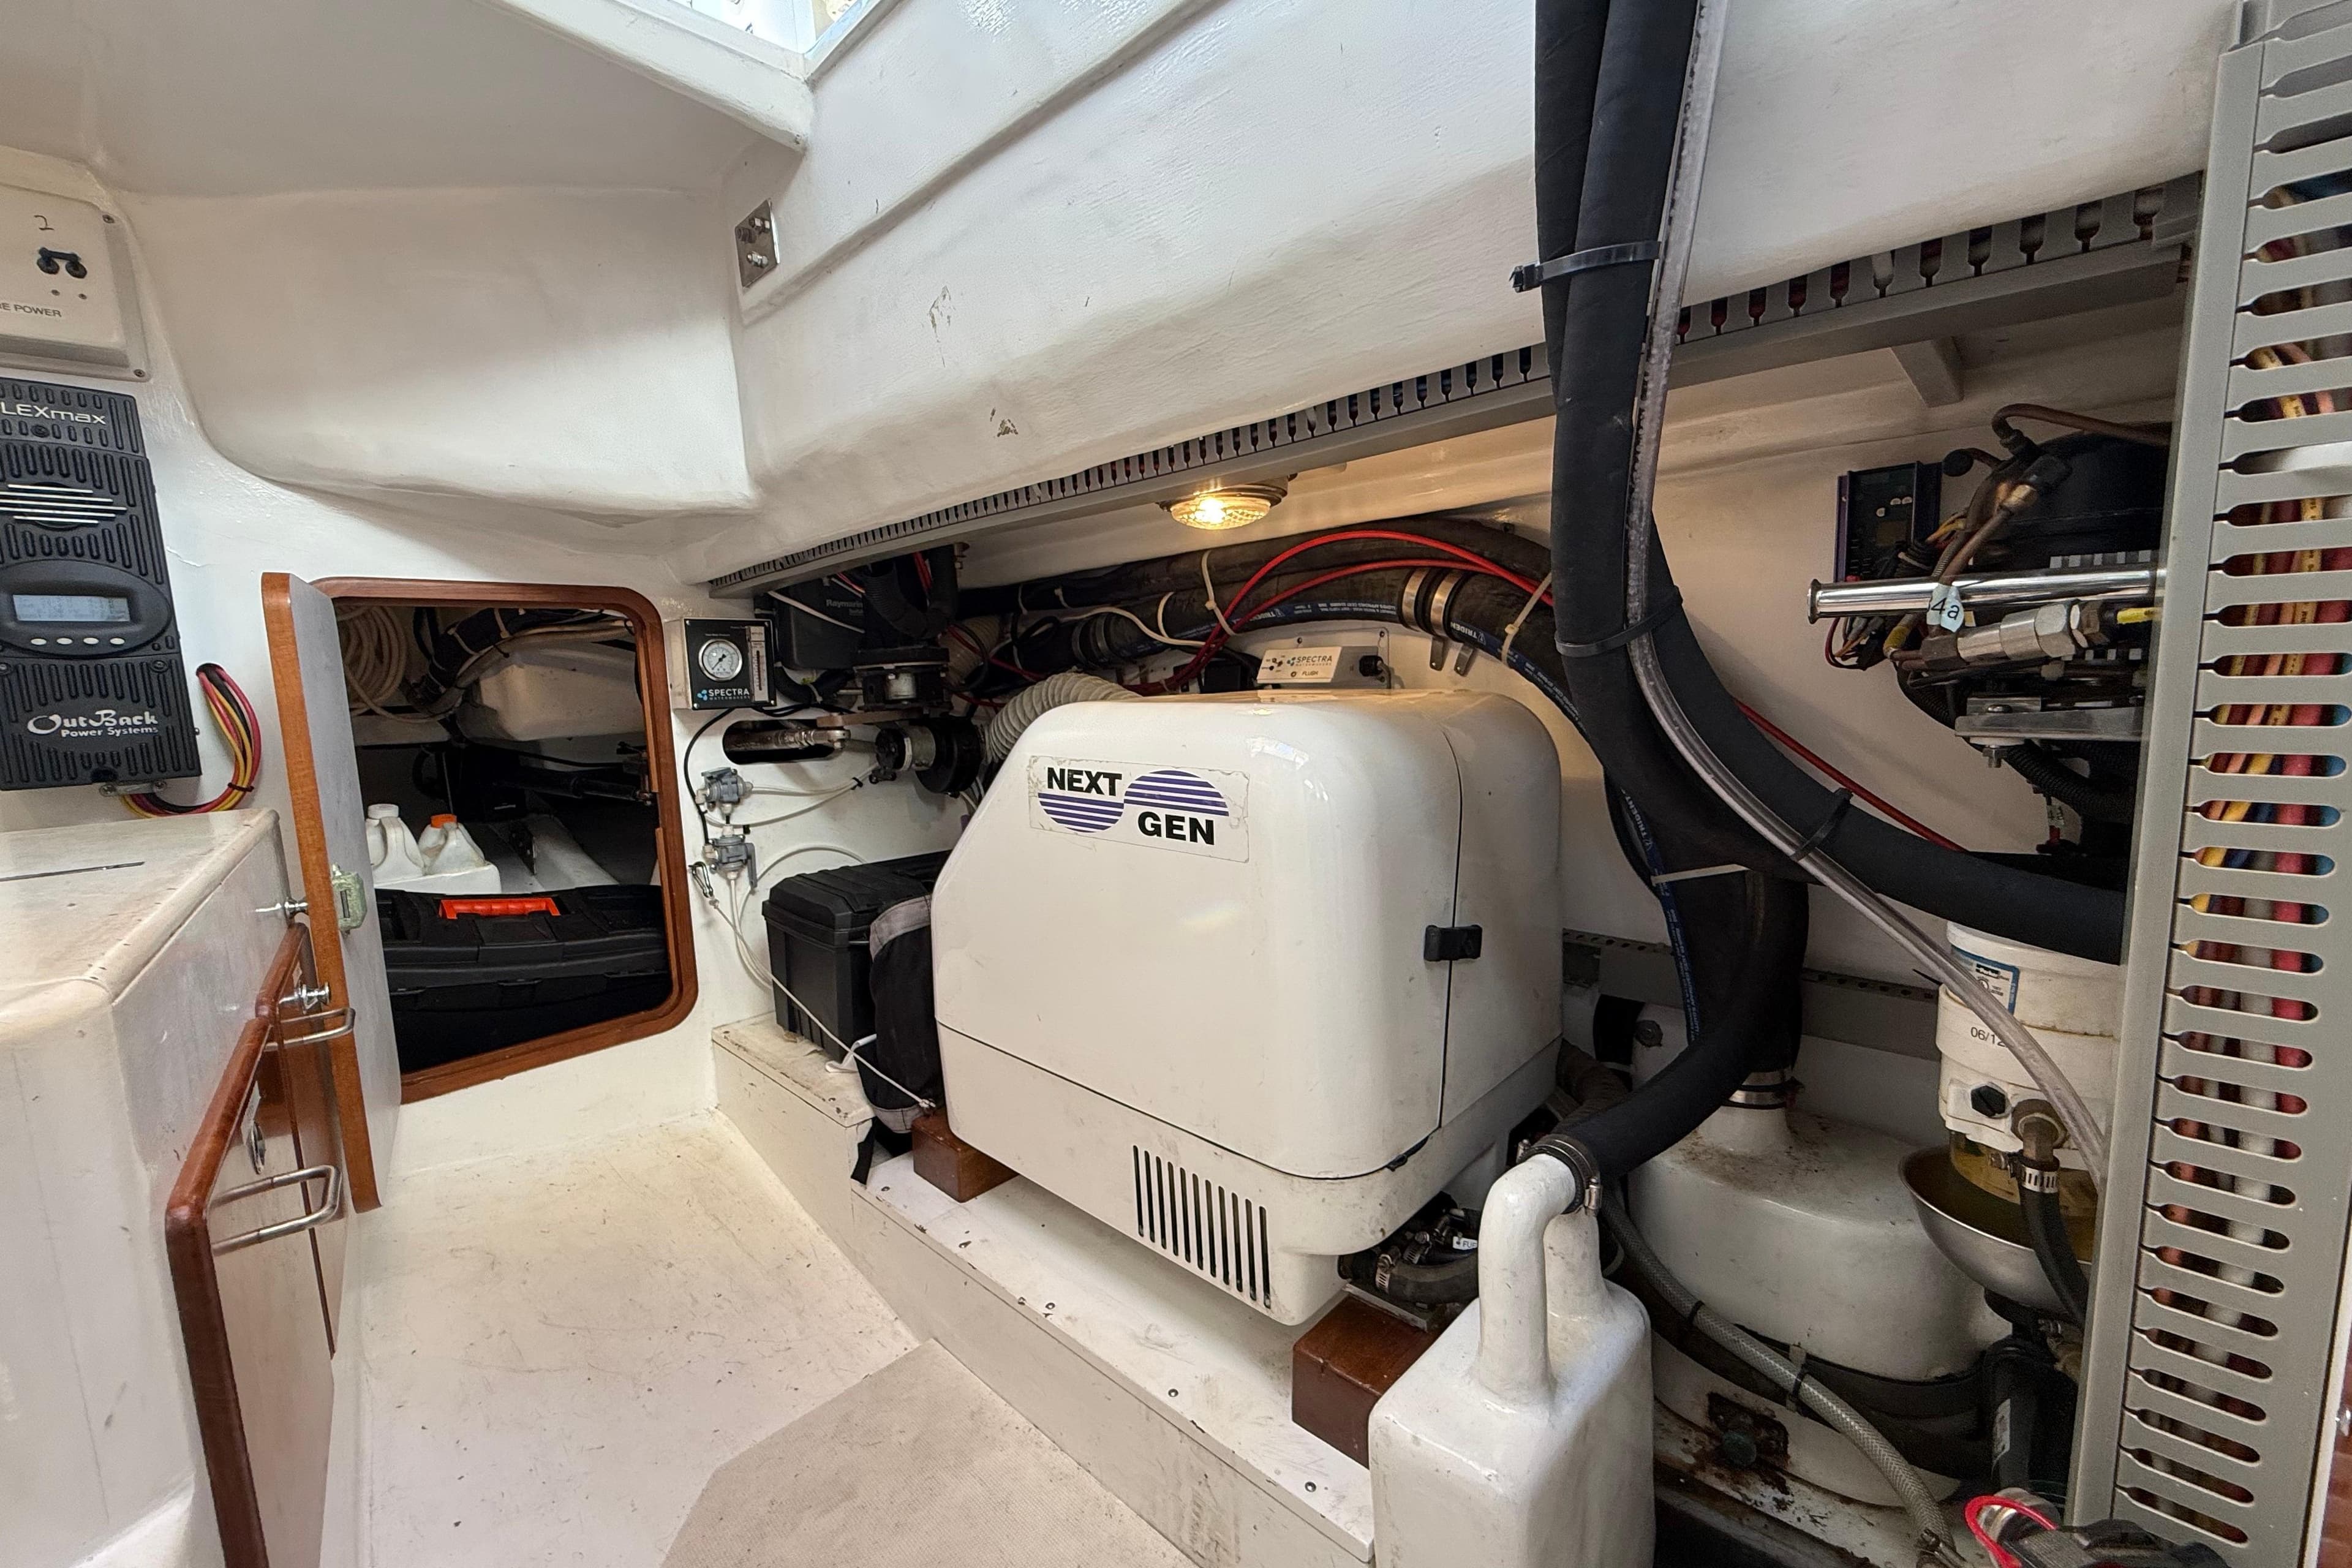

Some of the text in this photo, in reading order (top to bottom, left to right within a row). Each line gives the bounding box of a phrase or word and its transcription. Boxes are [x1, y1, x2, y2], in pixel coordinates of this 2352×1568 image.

[34, 215, 55, 231] 2
[13, 304, 62, 317] POWER
[0, 401, 107, 425] LEXmax
[826, 598, 863, 608] Raymarin
[1928, 597, 1961, 620] 4a
[708, 688, 750, 697] SPECTRA
[27, 709, 159, 734] OutBack
[107, 727, 159, 737] Systems
[1047, 766, 1123, 797] NEXT
[1137, 810, 1215, 846] GEN
